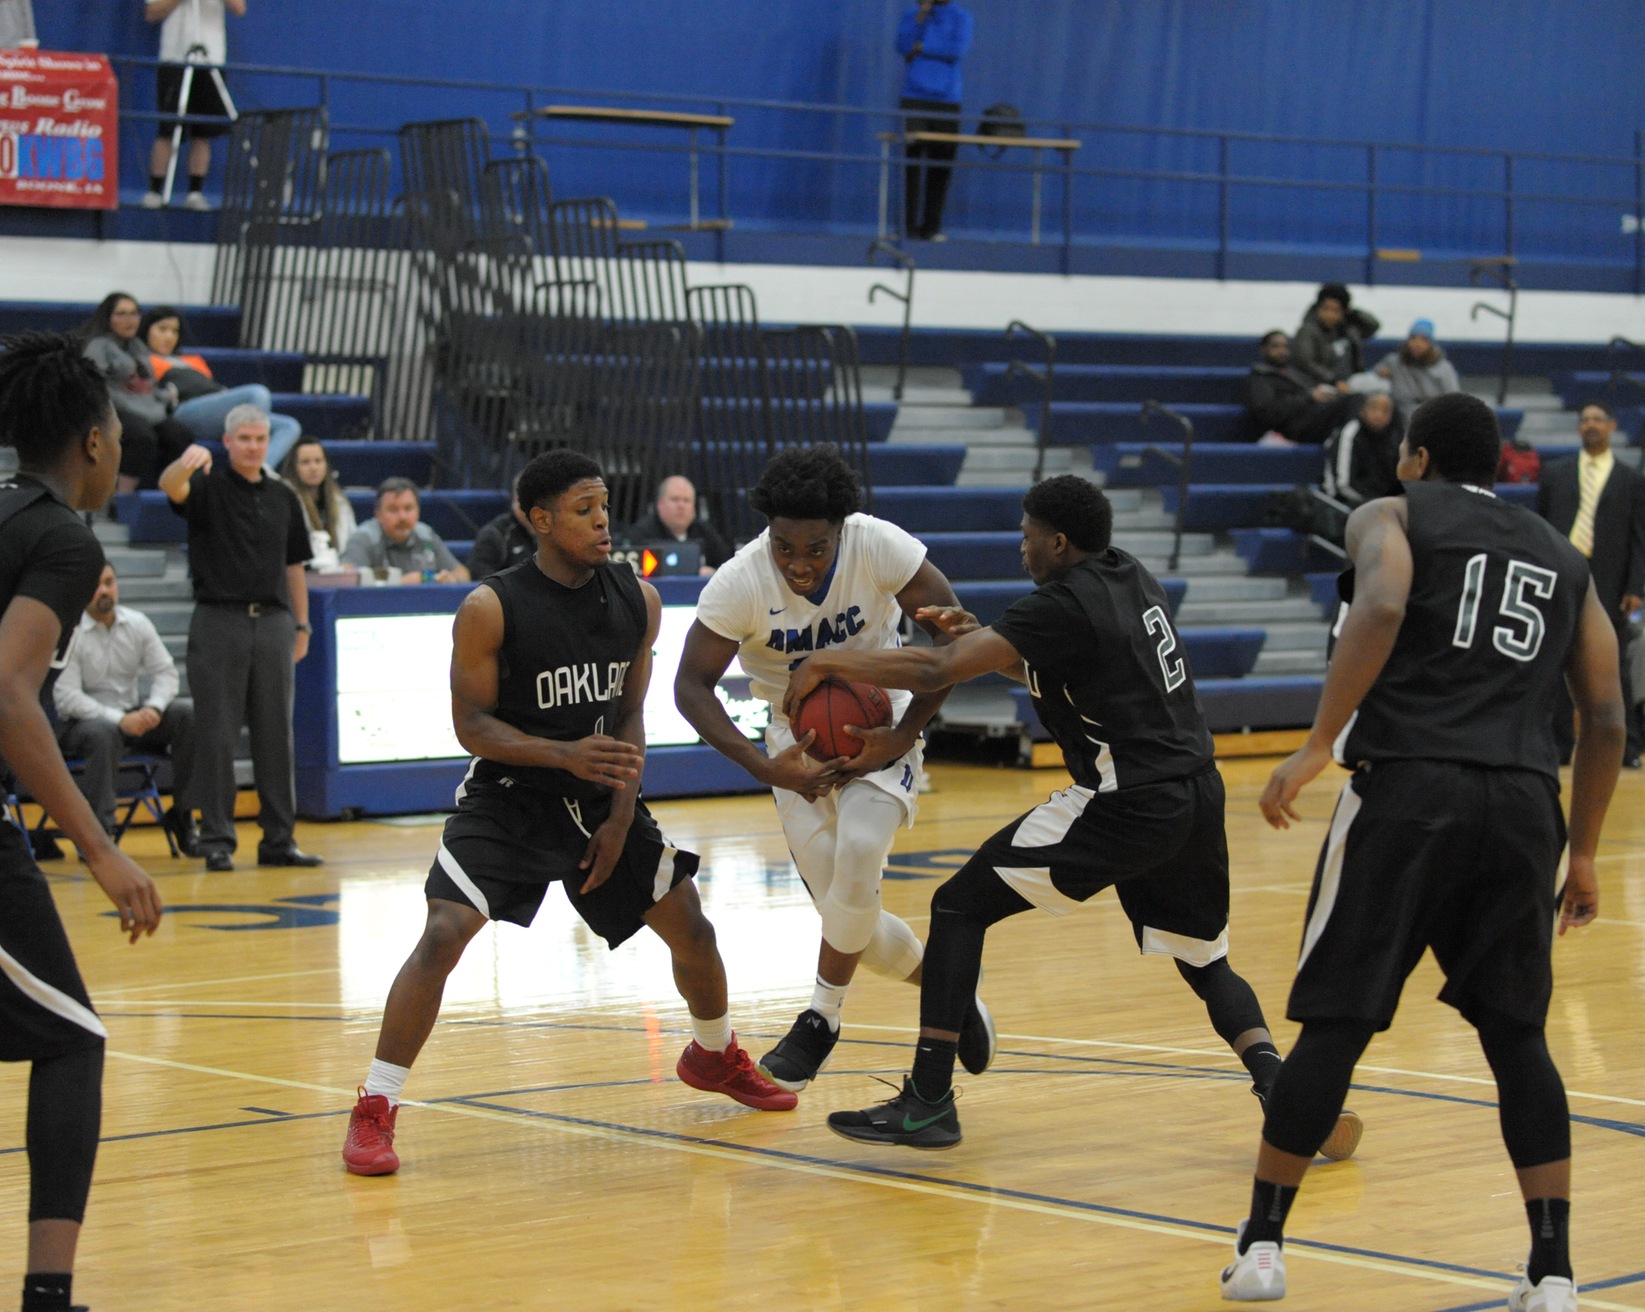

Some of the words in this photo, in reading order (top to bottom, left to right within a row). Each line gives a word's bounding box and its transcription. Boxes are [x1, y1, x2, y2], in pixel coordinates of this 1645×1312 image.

[34, 117, 103, 138] Radio
[1142, 605, 1187, 694] 2
[1452, 553, 1558, 662] 15
